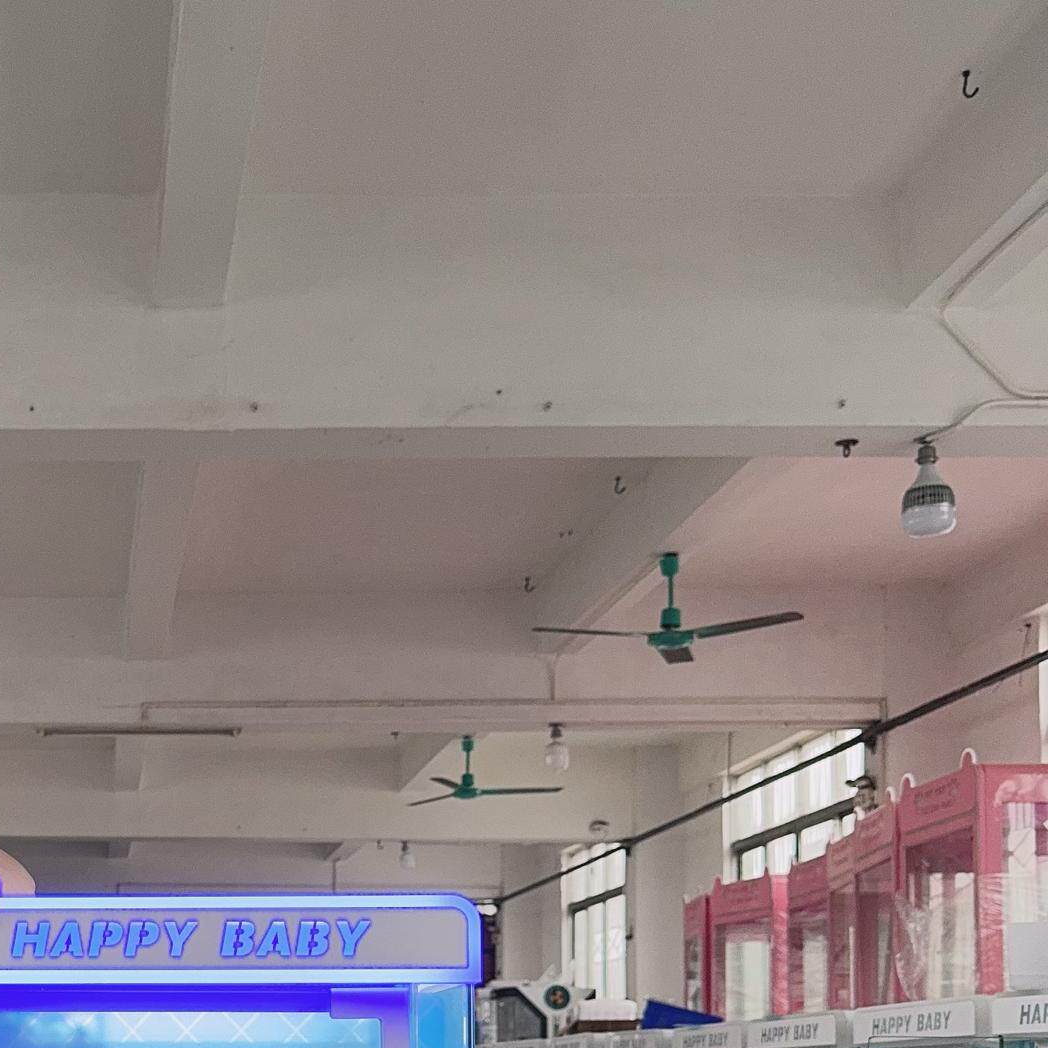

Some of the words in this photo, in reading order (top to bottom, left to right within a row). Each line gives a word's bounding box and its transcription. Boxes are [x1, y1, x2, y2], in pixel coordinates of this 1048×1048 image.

[11, 920, 198, 957] HAPPY
[220, 920, 370, 957] BABY
[761, 1025, 790, 1043] HAPPY
[793, 1023, 819, 1040] BABY
[872, 1015, 912, 1036] HAPPY
[916, 1010, 951, 1032] BABY
